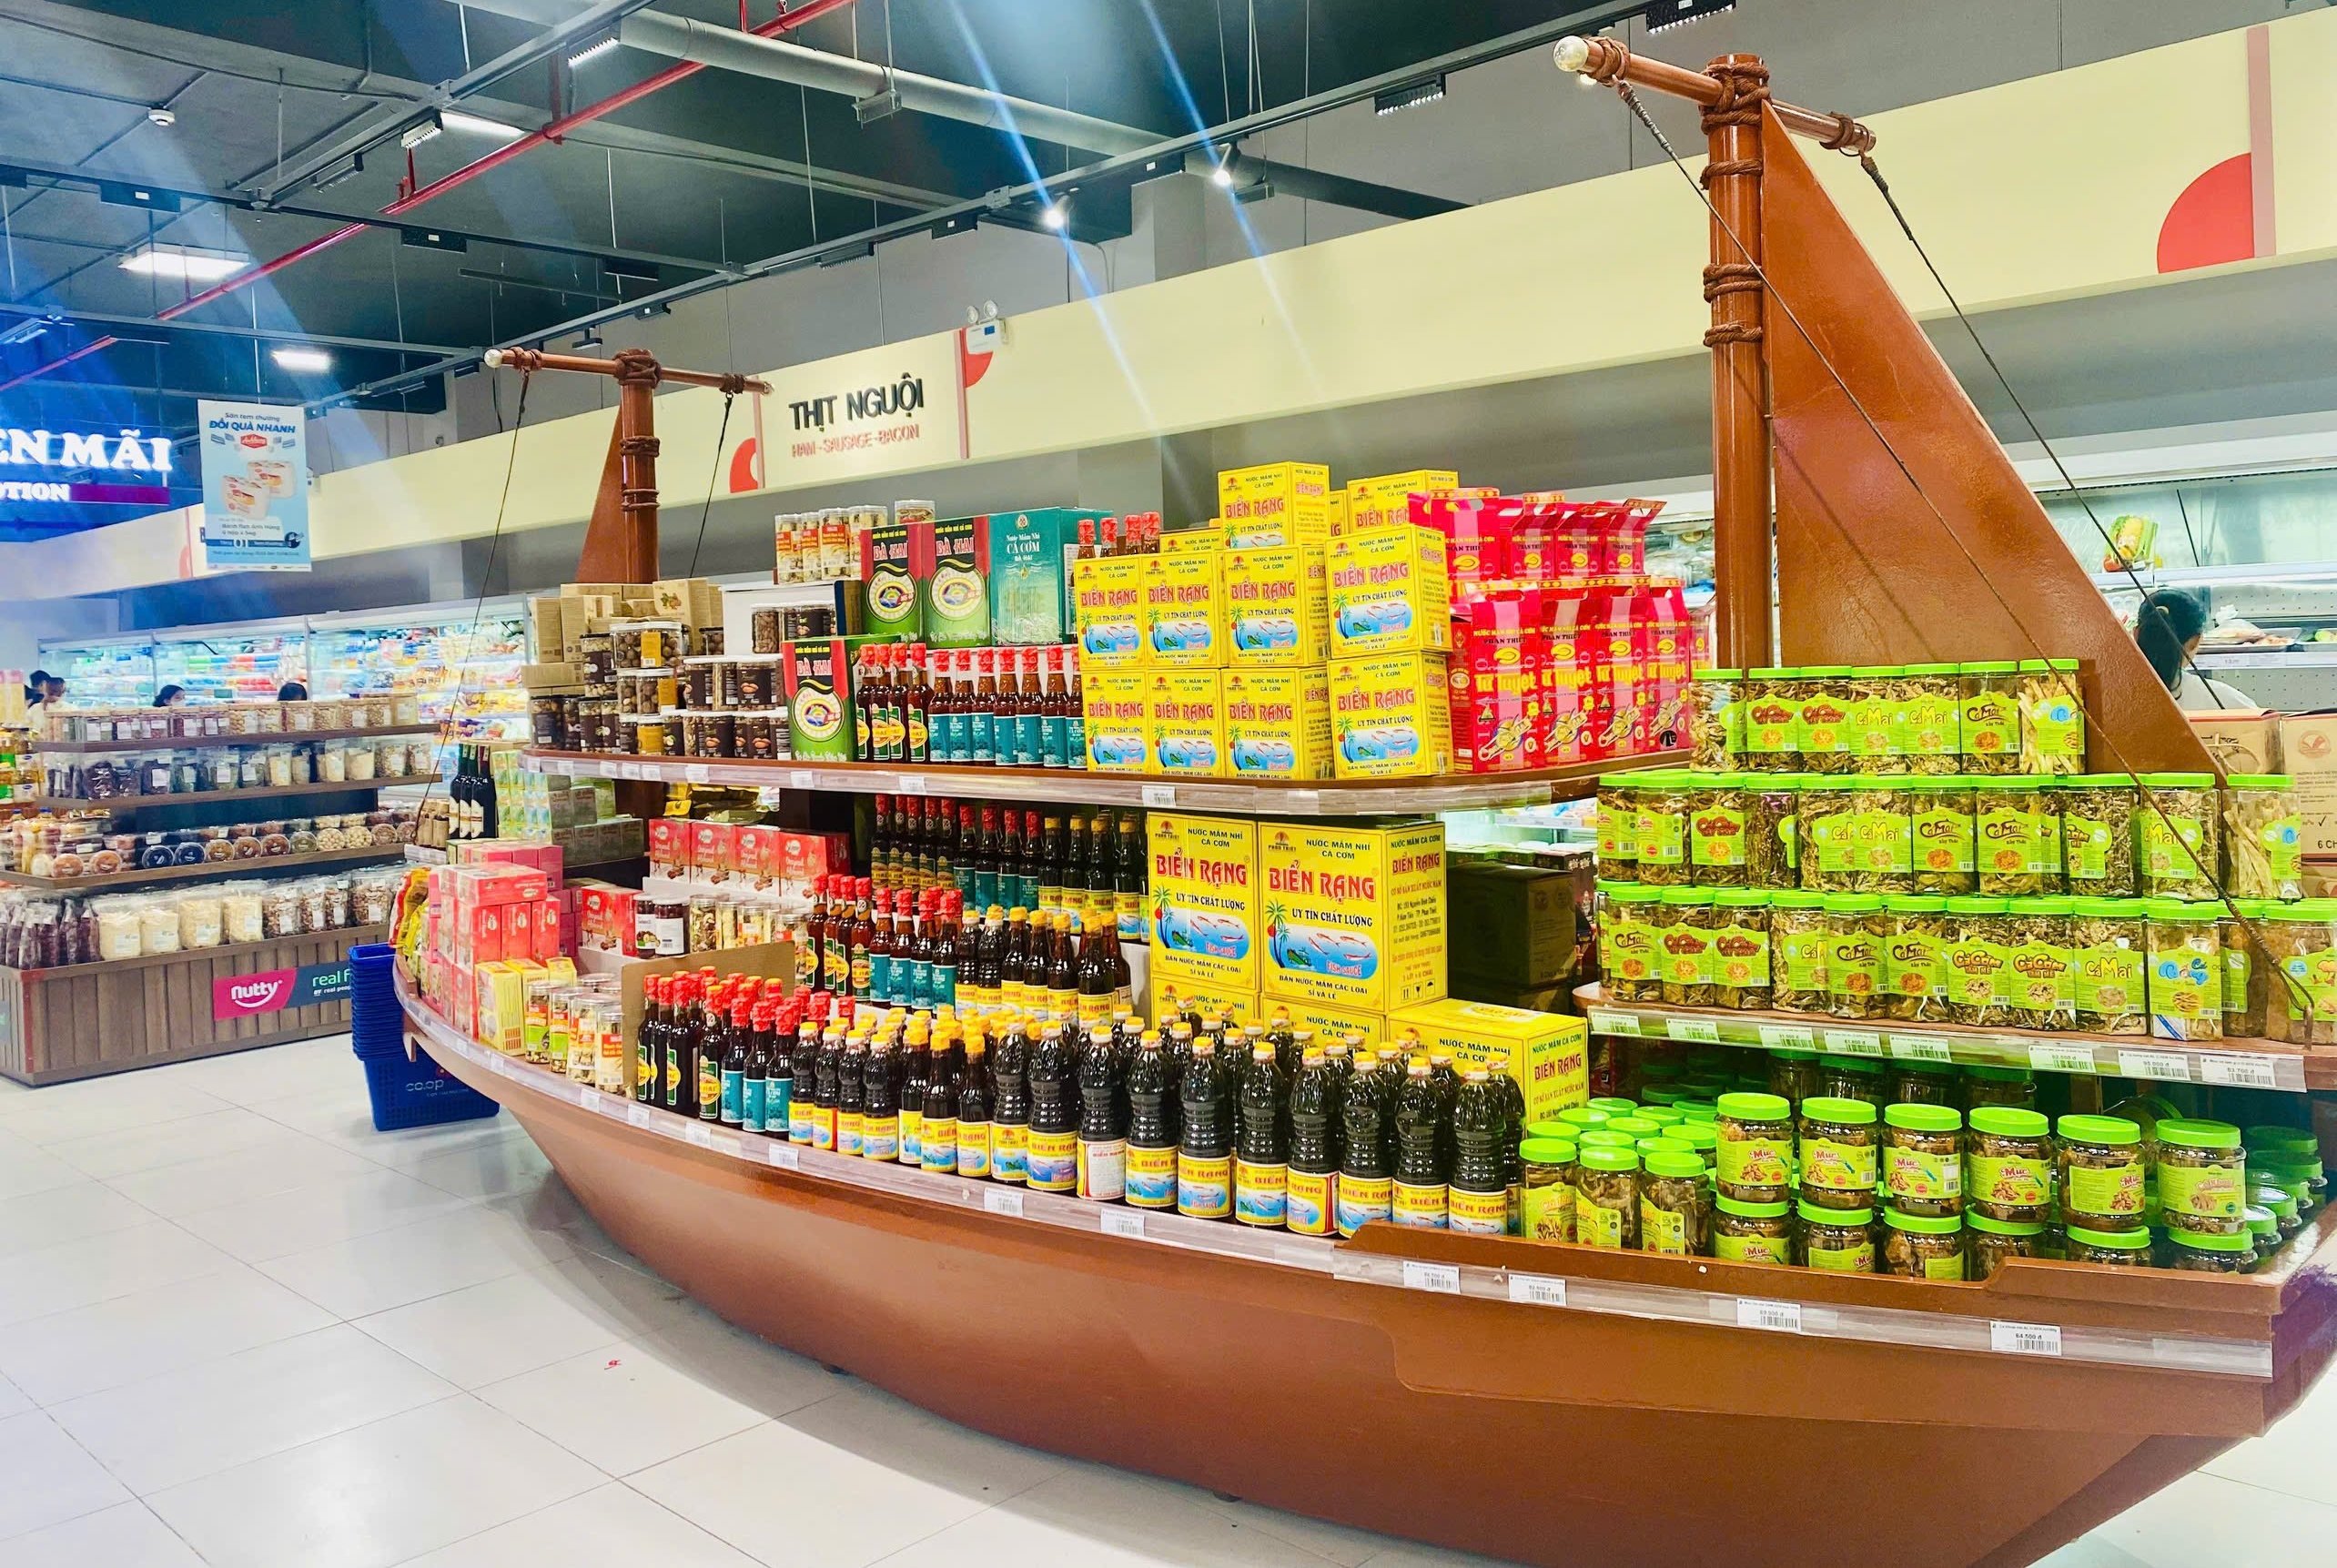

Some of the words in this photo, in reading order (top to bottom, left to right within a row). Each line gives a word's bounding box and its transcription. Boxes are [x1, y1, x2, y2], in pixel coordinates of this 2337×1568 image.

[789, 395, 837, 432] THỊT
[846, 372, 924, 420] NGUỘI
[231, 421, 254, 430] QUÀ
[256, 423, 296, 433] NHANH
[792, 441, 815, 457] HAM
[824, 432, 872, 452] SAUSAGE
[878, 424, 919, 444] BACON
[60, 429, 173, 470] MÃI
[1156, 847, 1195, 879] BIỂN
[1199, 859, 1249, 889] RẠNG
[1269, 859, 1314, 895] BIỂN
[1320, 872, 1377, 905] RẠNG
[1292, 907, 1302, 919] UY
[231, 981, 278, 999] nutty
[312, 970, 340, 987] real
